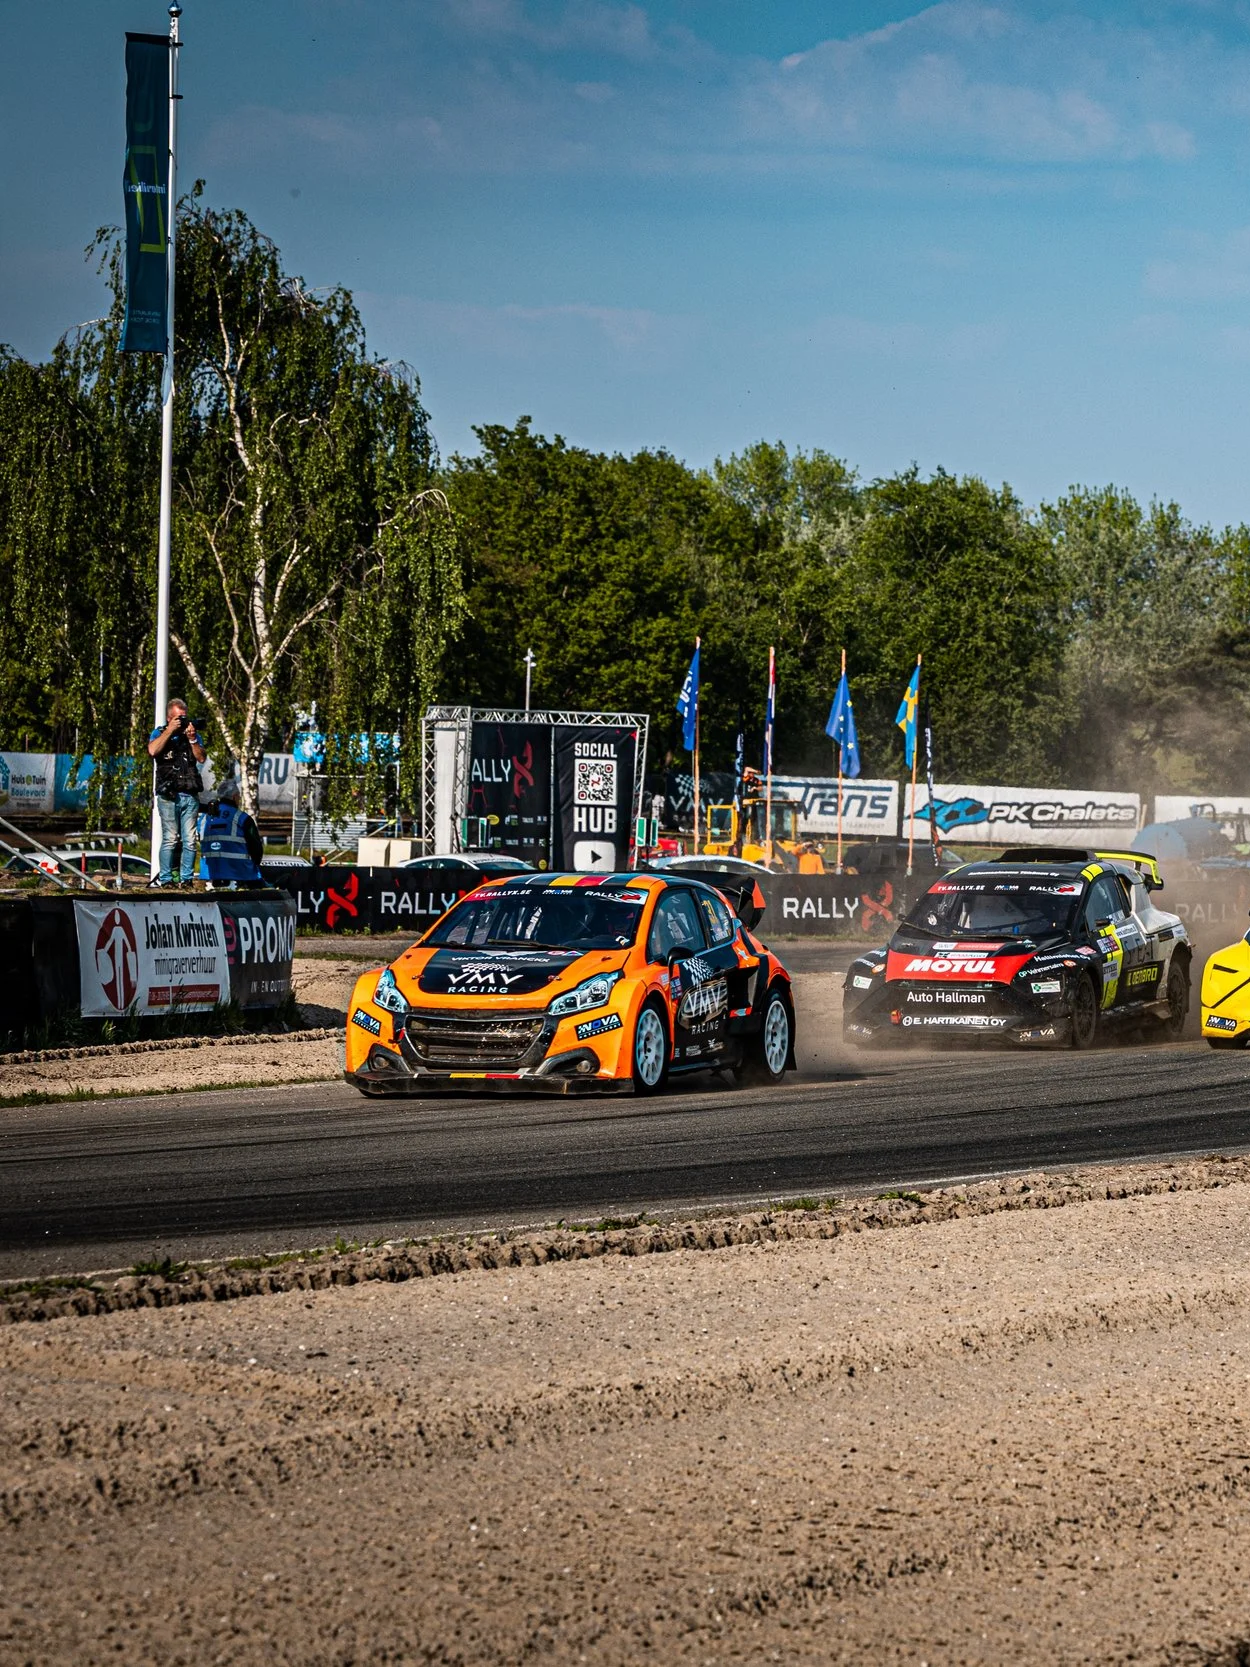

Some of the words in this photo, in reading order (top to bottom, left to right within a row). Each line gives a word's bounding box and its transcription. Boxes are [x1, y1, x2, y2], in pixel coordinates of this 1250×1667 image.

[574, 743, 618, 758] SOCIAL
[32, 775, 46, 785] Tuin
[11, 787, 46, 797] Boulevard
[989, 804, 1031, 821] PK
[1031, 803, 1136, 822] Chalets
[573, 807, 617, 833] HUB
[144, 914, 174, 950] Johan
[174, 912, 220, 948] Kwinten
[153, 951, 217, 982] minigraververhuur
[904, 959, 996, 974] MOTUL
[448, 972, 524, 985] VMV
[447, 986, 509, 994] RACING
[907, 991, 933, 1003] Auto
[936, 991, 986, 1003] Hallman
[687, 984, 722, 1018] VMV
[692, 1021, 719, 1034] RACING
[913, 1017, 922, 1025] E.
[924, 1016, 989, 1026] HARTIKAINEN
[990, 1018, 1007, 1026] OY
